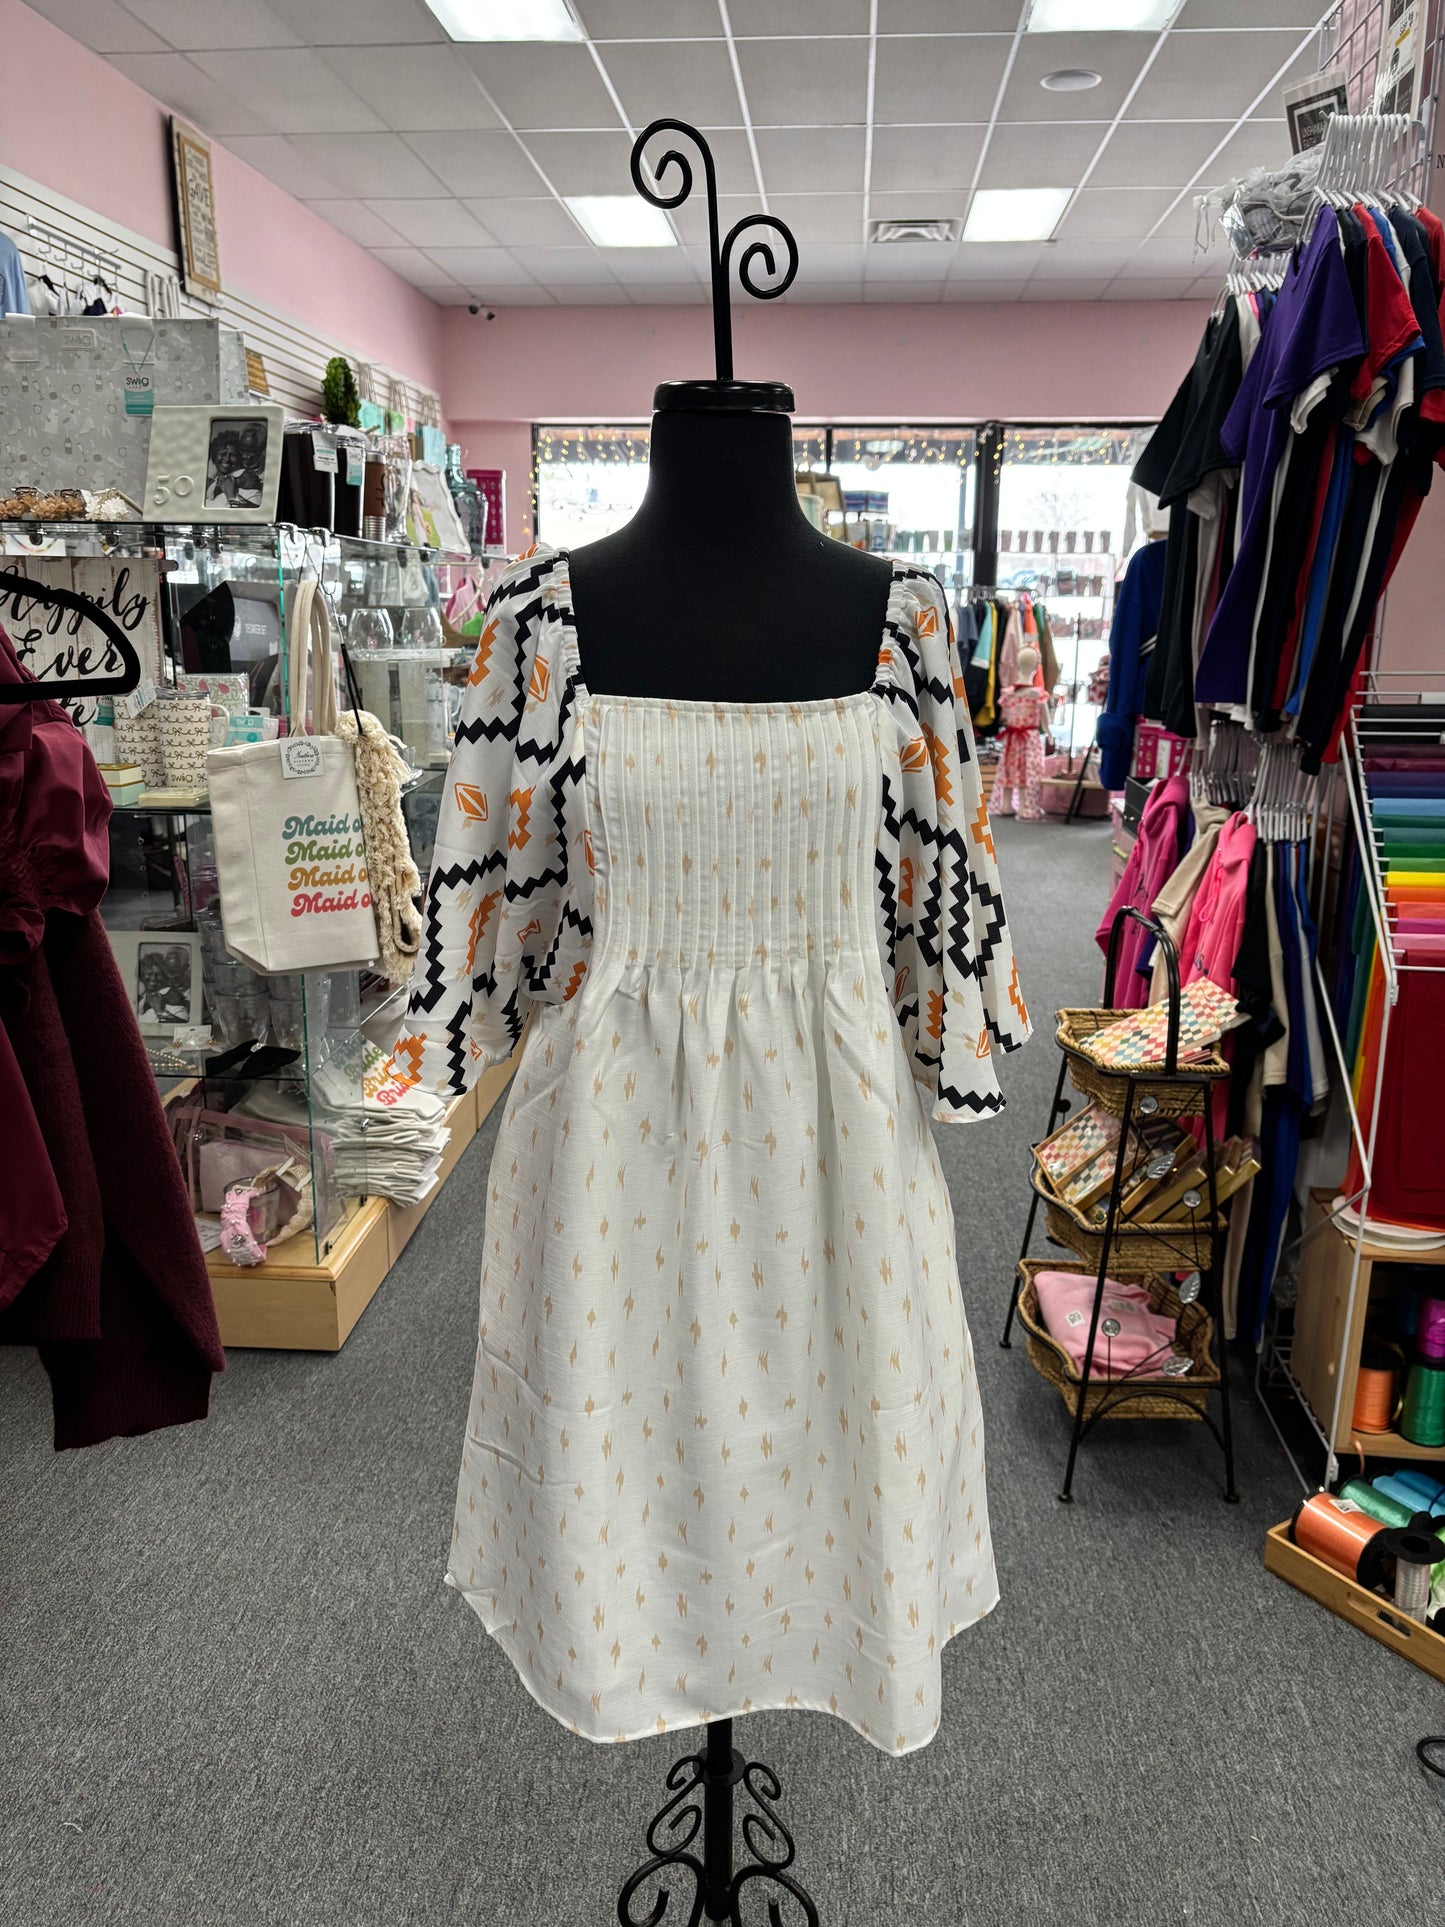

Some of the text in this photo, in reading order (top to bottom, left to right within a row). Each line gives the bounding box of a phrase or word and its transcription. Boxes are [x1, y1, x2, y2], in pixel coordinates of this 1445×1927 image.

[126, 376, 150, 388] swig
[152, 474, 195, 506] 50
[171, 772, 194, 784] swig
[282, 812, 351, 840] Maid
[285, 837, 354, 866] Maid
[288, 862, 357, 892] Maid
[291, 888, 360, 918] Maid
